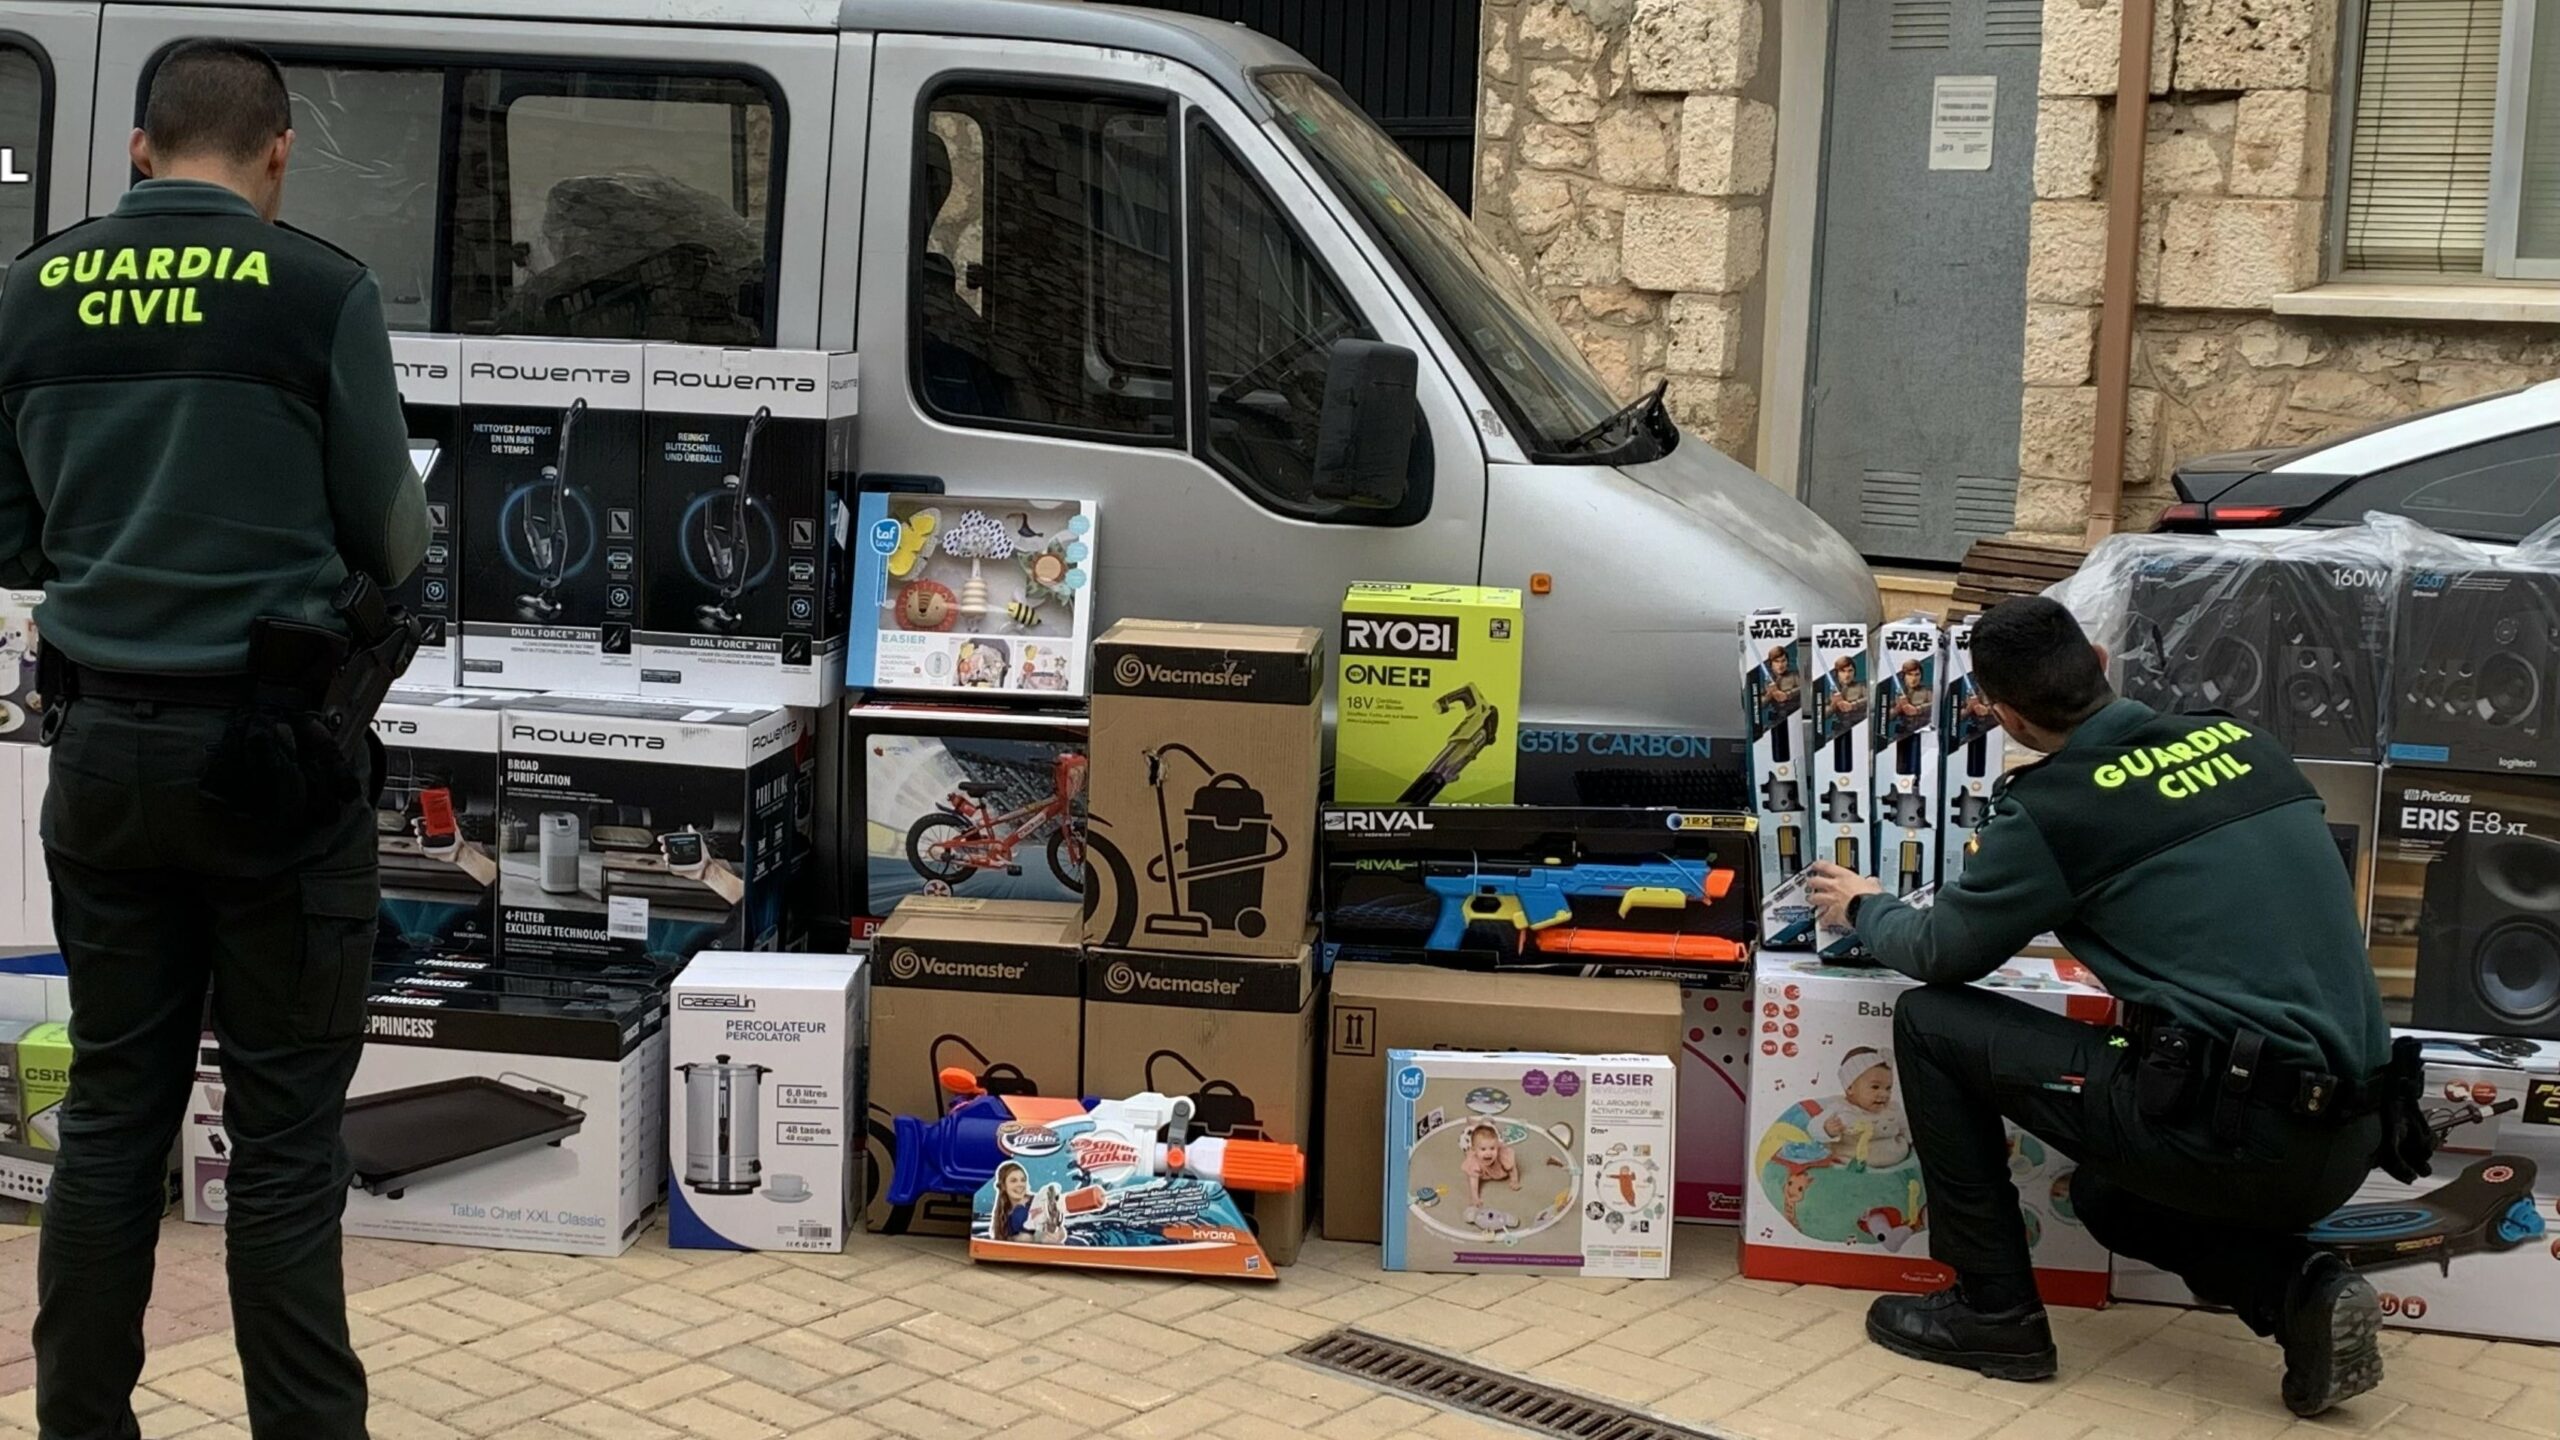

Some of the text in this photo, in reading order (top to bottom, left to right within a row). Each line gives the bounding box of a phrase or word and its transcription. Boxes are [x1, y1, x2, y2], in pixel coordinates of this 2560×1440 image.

[39, 246, 270, 287] GUARDIA
[78, 287, 203, 325] CIVIL
[473, 423, 552, 435] NETTOYEZ PARTOUT
[491, 435, 534, 445] EN UN RIEN
[678, 432, 710, 442] REINIGT
[492, 445, 502, 453] DE
[504, 445, 529, 455] TEMPS
[665, 442, 722, 453] BLITZSCHNELL
[665, 453, 682, 462] UND
[2332, 569, 2388, 588] 160W
[1749, 618, 1795, 629] STAR
[511, 628, 535, 637] DUAL
[576, 631, 597, 640] 2IN1
[881, 633, 927, 645] EASIER
[1346, 619, 1451, 653] RYOBI
[1750, 628, 1795, 640] WARS
[1816, 628, 1864, 639] STAR
[1885, 631, 1933, 642] STAR
[690, 638, 713, 647] DUAL
[756, 641, 777, 651] 2IN1
[1817, 638, 1864, 649] WARS
[1886, 641, 1933, 652] WARS
[1146, 662, 1253, 687] Vacmaster
[1346, 696, 1374, 709] 18V
[1518, 728, 1712, 759] G513 CARBON
[2094, 721, 2253, 788] GUARDIA
[507, 758, 539, 771] BROAD
[507, 771, 571, 787] PURIFICATION
[2158, 753, 2253, 798] CIVIL
[2420, 790, 2472, 804] PreSonus
[1347, 811, 1434, 832] RIVAL
[2401, 806, 2528, 836] ERIS E8 XT
[1356, 858, 1404, 871] RIVAL
[505, 922, 552, 937] EXCLUSIVE
[554, 925, 611, 941] TECHNOLOGY
[423, 959, 488, 970] PRINCESS
[920, 956, 1024, 981] Vacmaster
[1615, 968, 1708, 980] PATHFINDER
[404, 977, 468, 988] PRINCESS
[1135, 971, 1241, 996] Vacmaster
[376, 995, 443, 1007] PRINCESS
[1857, 1001, 1893, 1018] Bab
[371, 1015, 434, 1038] PRINCESS
[726, 1020, 826, 1033] PERCOLATEUR
[726, 1031, 801, 1042] PERCOLATOR
[1402, 1072, 1421, 1085] taf
[1591, 1072, 1654, 1086] EASIER
[803, 1088, 828, 1098] litres
[799, 1126, 831, 1135] tasses
[450, 1203, 607, 1228] Table Chef XXL Classic
[1193, 1229, 1237, 1241] HYDRA
